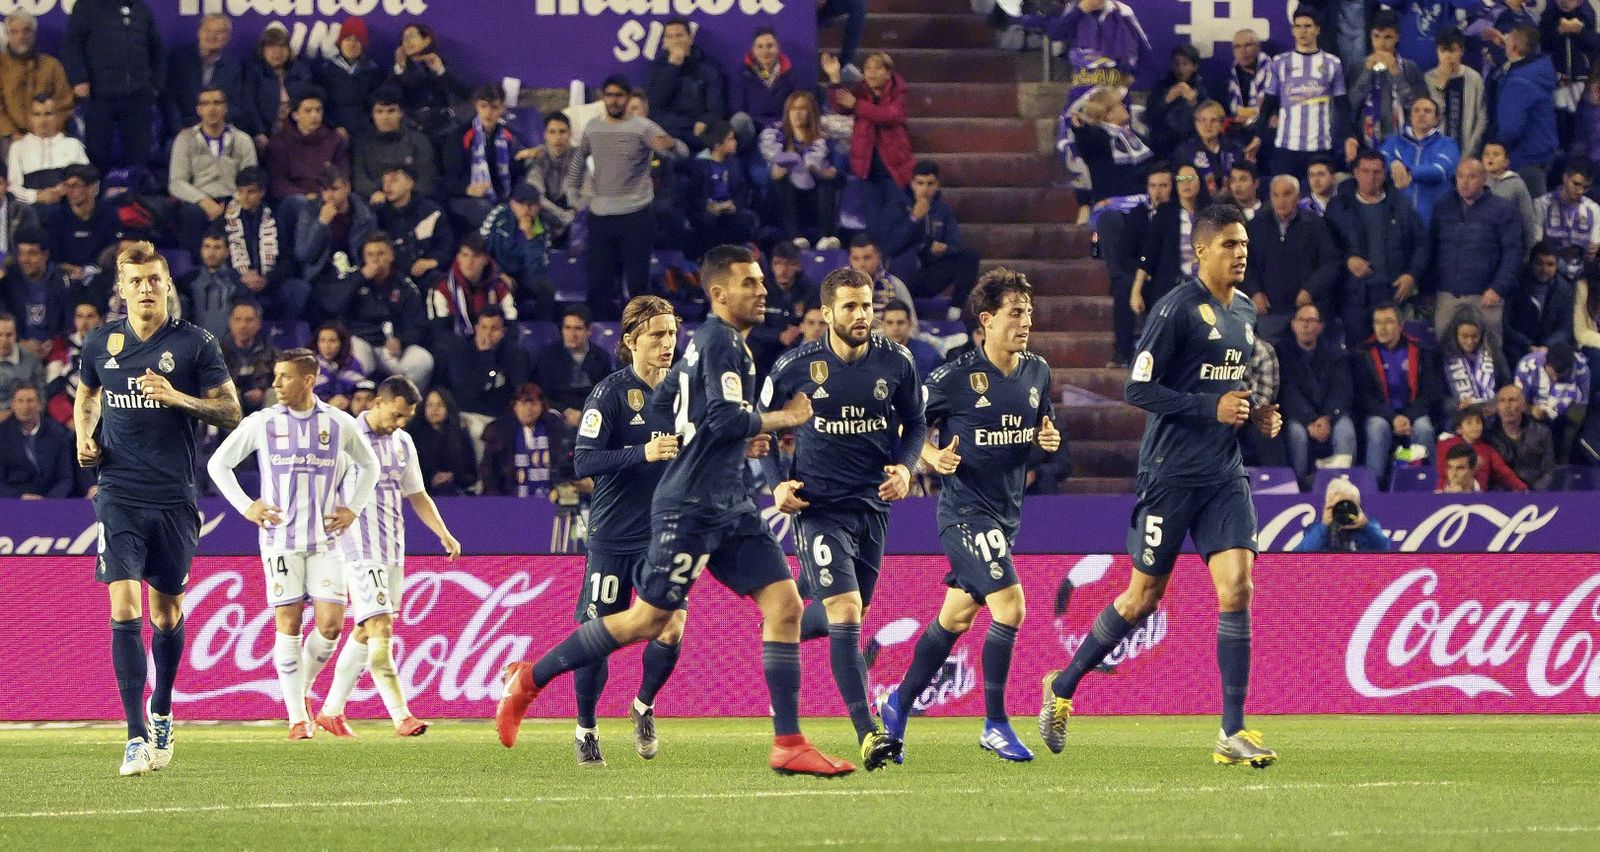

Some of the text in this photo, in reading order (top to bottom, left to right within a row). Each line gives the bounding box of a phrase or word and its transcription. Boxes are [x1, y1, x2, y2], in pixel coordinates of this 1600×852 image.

[265, 20, 343, 58] IN
[613, 19, 700, 63] SI
[1225, 349, 1242, 364] Fly
[1200, 363, 1247, 380] Emirat
[105, 389, 170, 409] Emirat
[841, 405, 865, 419] Fly
[1001, 414, 1022, 428] Fly
[975, 427, 1036, 446] Emirate
[1145, 515, 1164, 547] 5
[813, 534, 833, 567] 6
[974, 528, 1007, 563] 19
[267, 555, 289, 577] 14
[590, 572, 619, 604] 10
[1345, 567, 1600, 699] Coca-C
